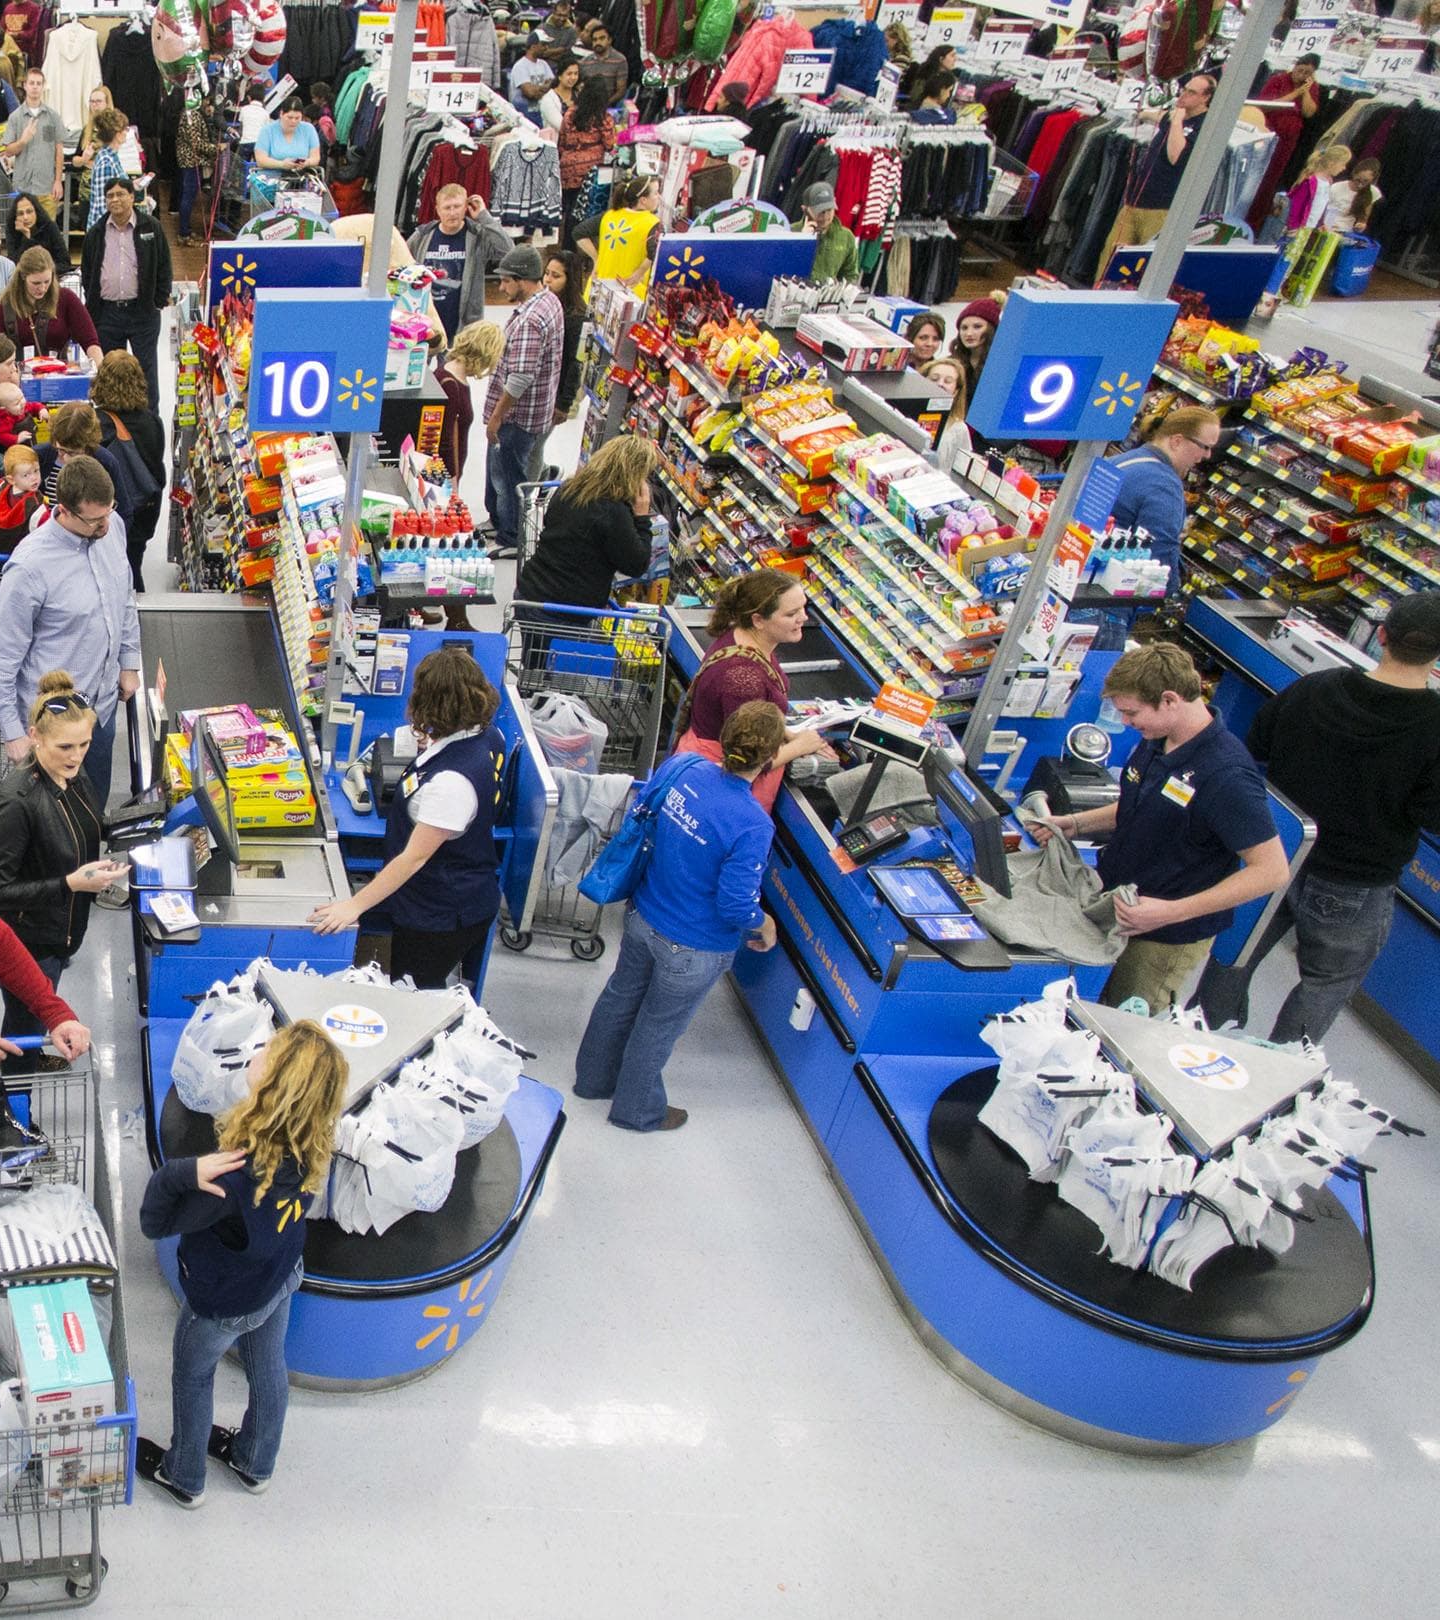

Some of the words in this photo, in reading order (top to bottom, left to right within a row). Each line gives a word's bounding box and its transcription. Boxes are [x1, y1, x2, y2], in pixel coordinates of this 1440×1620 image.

[263, 360, 330, 418] 10
[1023, 364, 1074, 424] 9
[769, 867, 790, 902] Save
[342, 1022, 376, 1034] THINK
